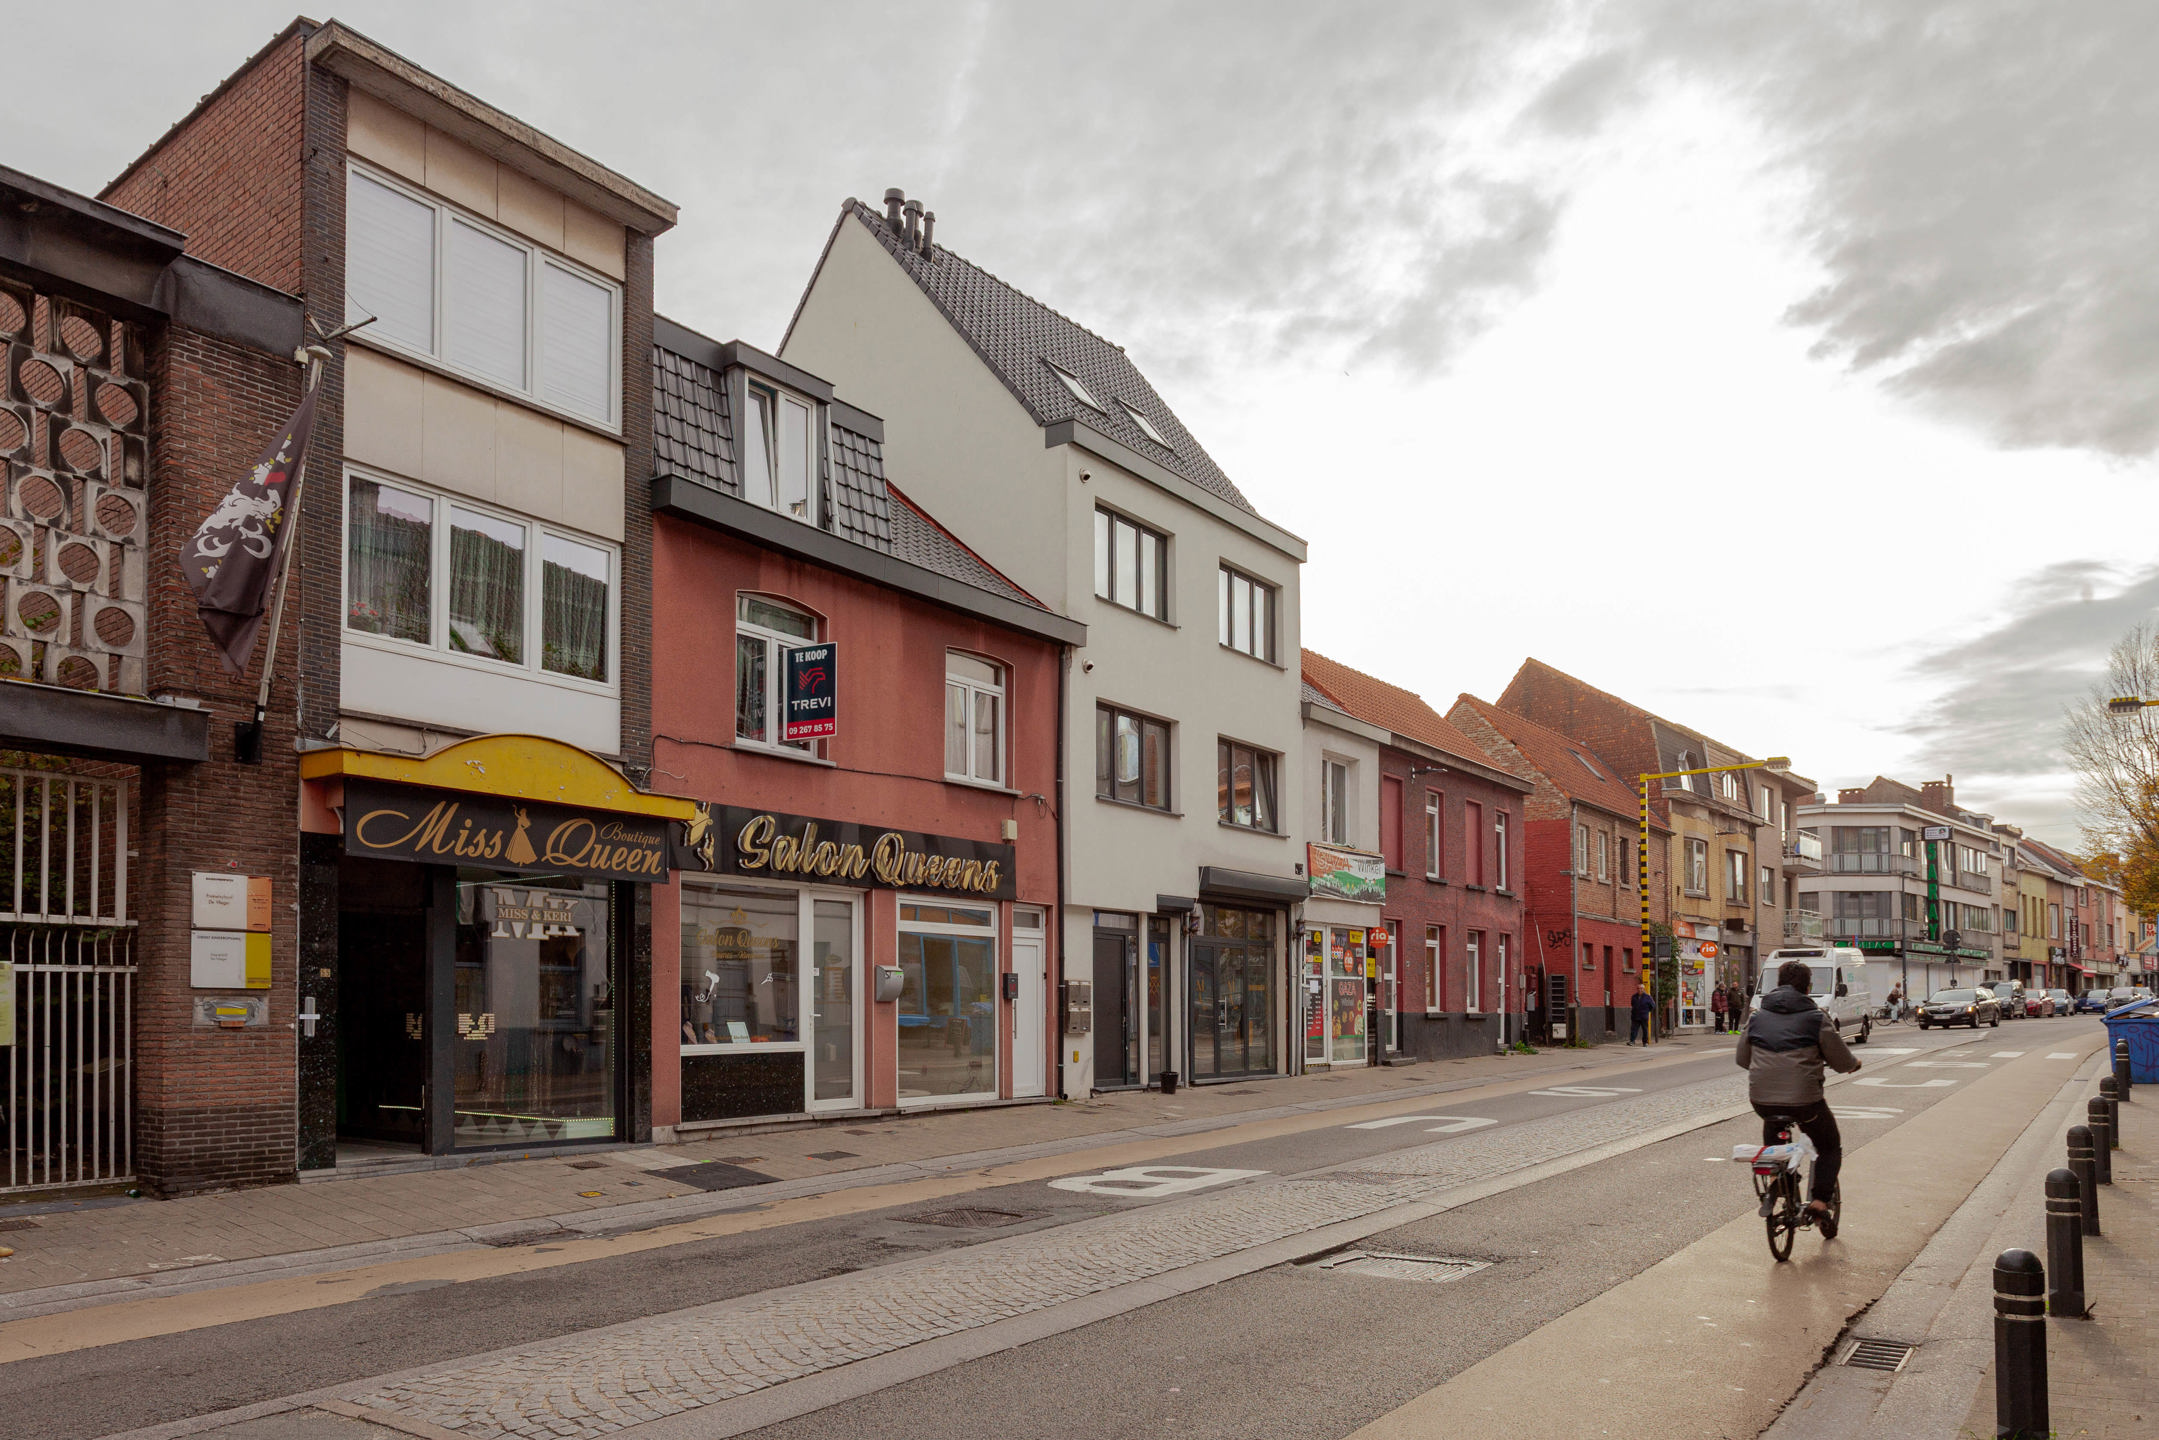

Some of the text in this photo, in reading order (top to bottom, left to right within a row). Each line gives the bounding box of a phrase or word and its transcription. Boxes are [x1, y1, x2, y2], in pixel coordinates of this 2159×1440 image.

[794, 649, 828, 663] TE KOOP
[791, 696, 832, 711] TREVI
[789, 722, 833, 735] 09 267 85 75
[356, 800, 503, 860] Miss
[600, 821, 661, 848] Boutique
[541, 817, 663, 876] Queen
[736, 814, 1004, 893] Salon Queens
[1927, 843, 1938, 940] SARAY
[497, 907, 572, 923] MISS & KERI
[1370, 929, 1387, 940] ria
[1701, 944, 1715, 953] ria
